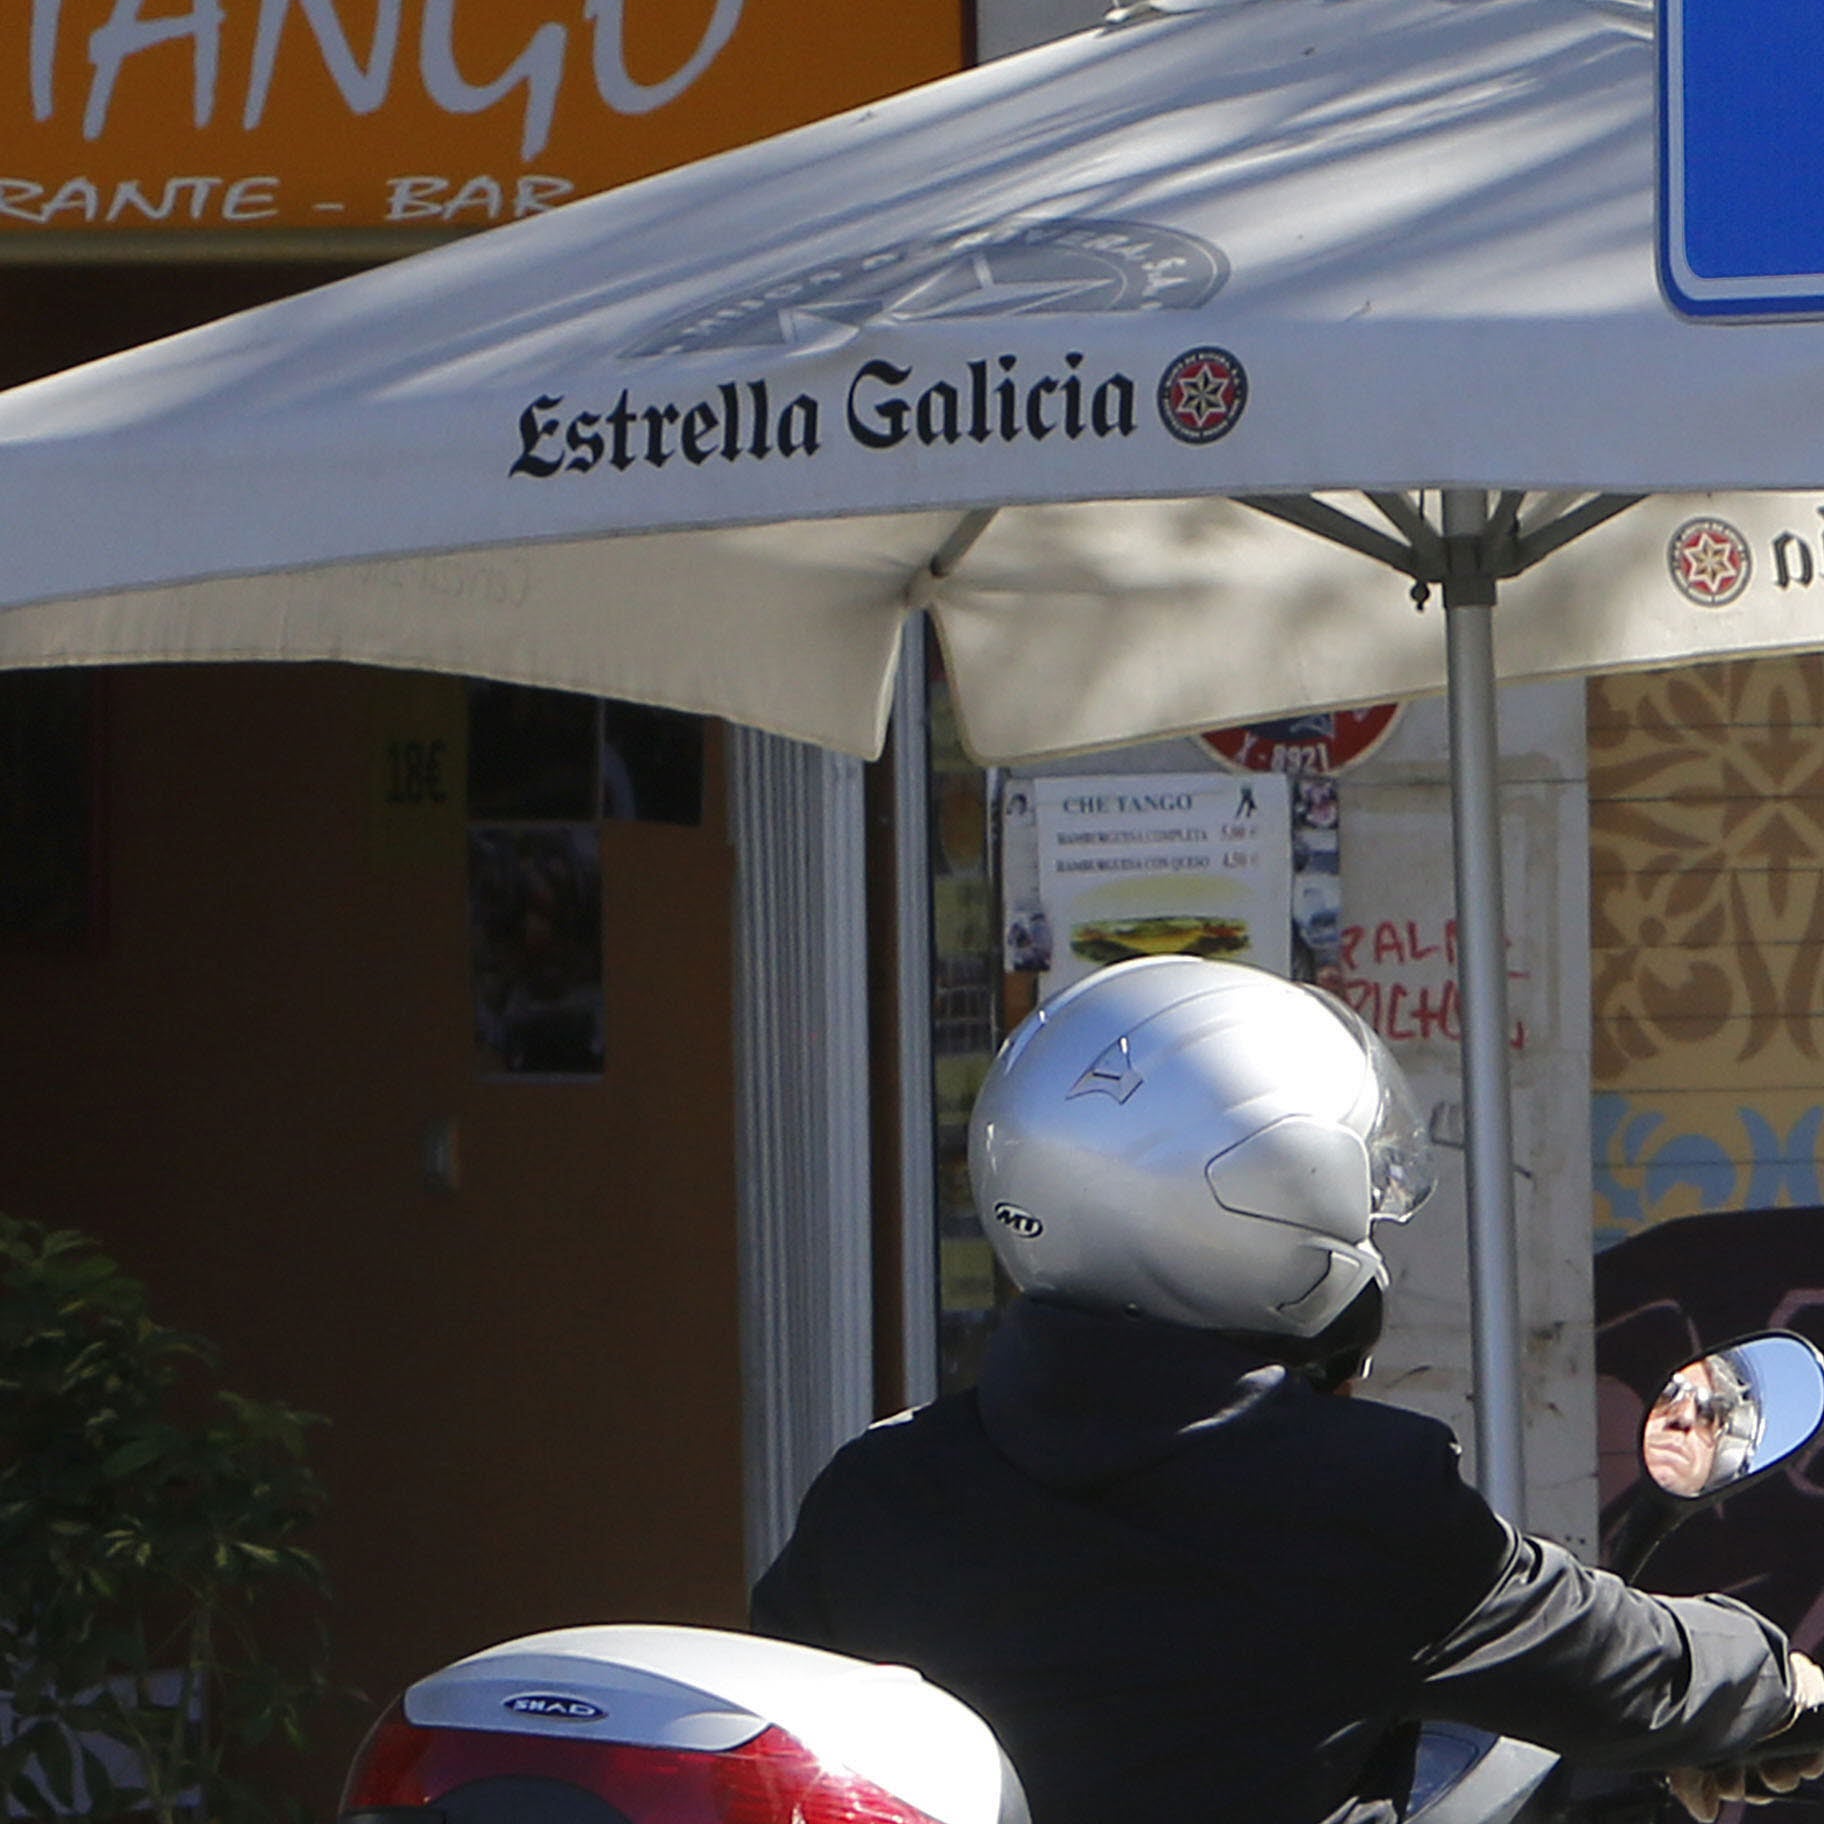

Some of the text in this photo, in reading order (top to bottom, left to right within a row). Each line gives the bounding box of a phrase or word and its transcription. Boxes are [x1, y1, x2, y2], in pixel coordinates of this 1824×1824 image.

[385, 176, 576, 221] BAR
[508, 378, 821, 479] Estrella
[846, 351, 1137, 450] Galicia
[1062, 792, 1193, 815] CHE TANGO
[513, 1698, 597, 1717] SHAD
